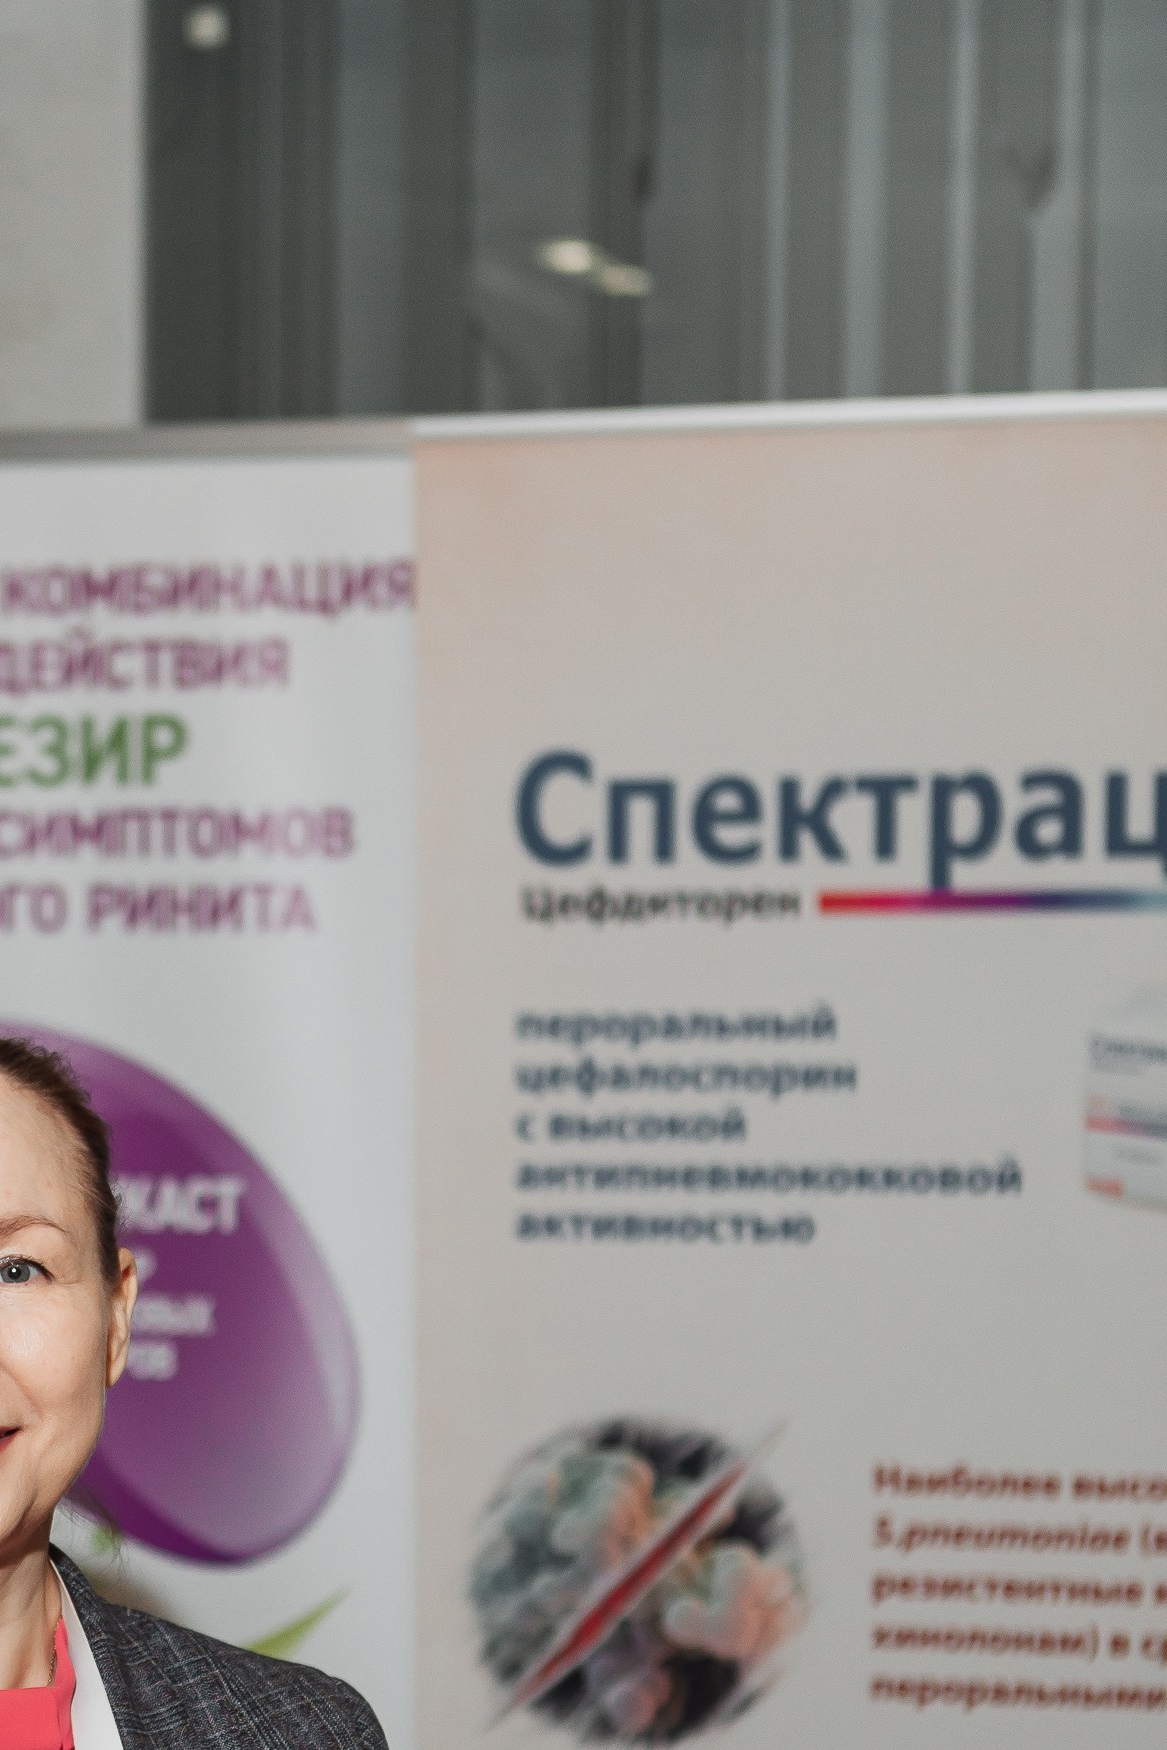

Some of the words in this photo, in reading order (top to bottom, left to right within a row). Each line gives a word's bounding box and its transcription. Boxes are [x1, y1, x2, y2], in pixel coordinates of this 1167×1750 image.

[2, 560, 416, 622] КОМБИНАЦИЯ
[88, 882, 317, 934] РИНИТА
[523, 887, 801, 930] Цефдиторен
[516, 1003, 838, 1046] пероральный
[516, 1060, 857, 1101] цефалоспорин
[548, 1107, 747, 1143] высокой
[516, 1156, 1023, 1195] антипневмококковой
[516, 1214, 815, 1244] активностью
[873, 1462, 1061, 1500] Наиболее
